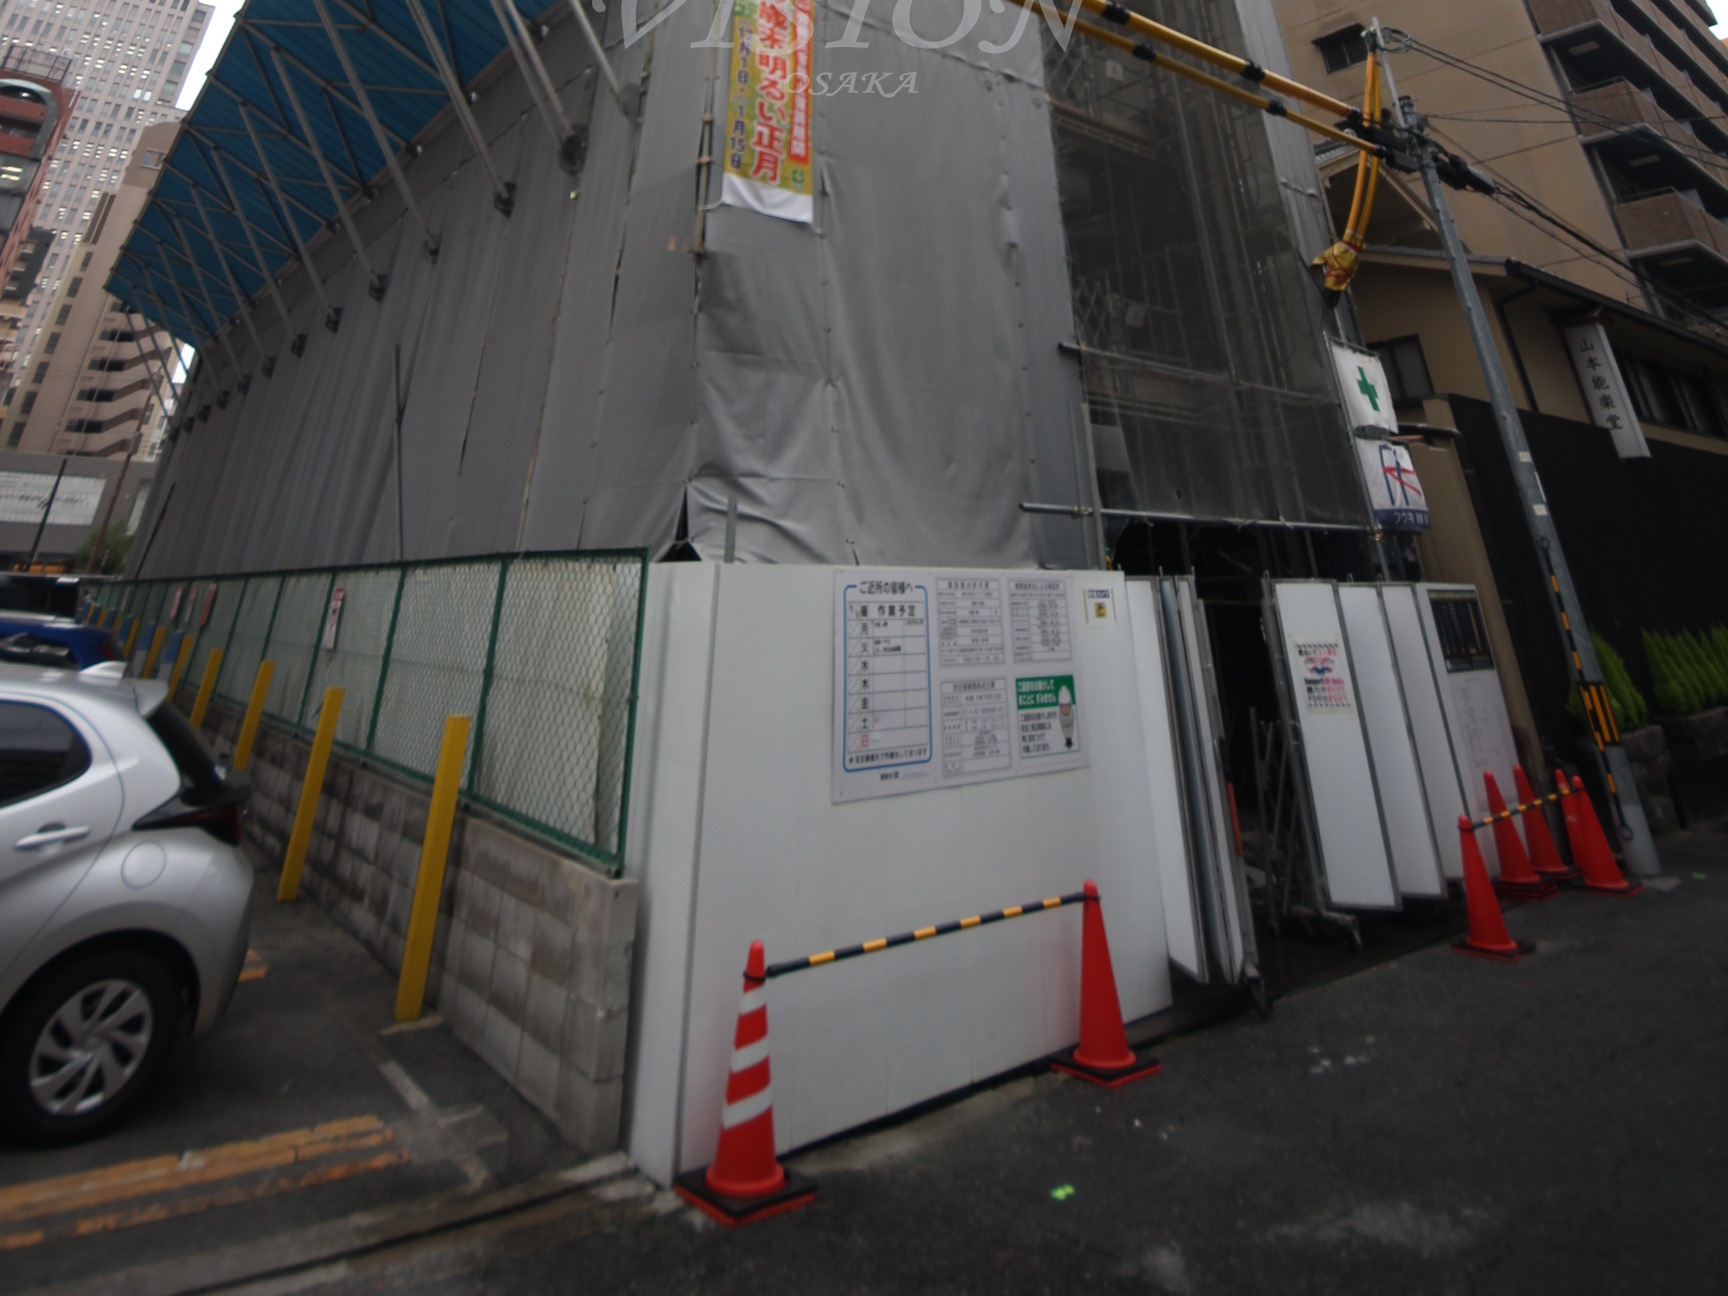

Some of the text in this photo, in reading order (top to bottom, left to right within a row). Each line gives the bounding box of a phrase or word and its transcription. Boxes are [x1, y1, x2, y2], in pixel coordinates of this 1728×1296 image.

[1579, 338, 1624, 431] 山本能楽堂
[859, 580, 914, 595] ご近所の皆様へ
[877, 604, 916, 618] 作業予定
[861, 621, 869, 635] 月
[861, 641, 869, 654] 火
[861, 659, 869, 672] 水
[861, 678, 869, 691] 木
[861, 697, 869, 710] 金
[861, 716, 869, 730] 土
[861, 733, 869, 749] 日
